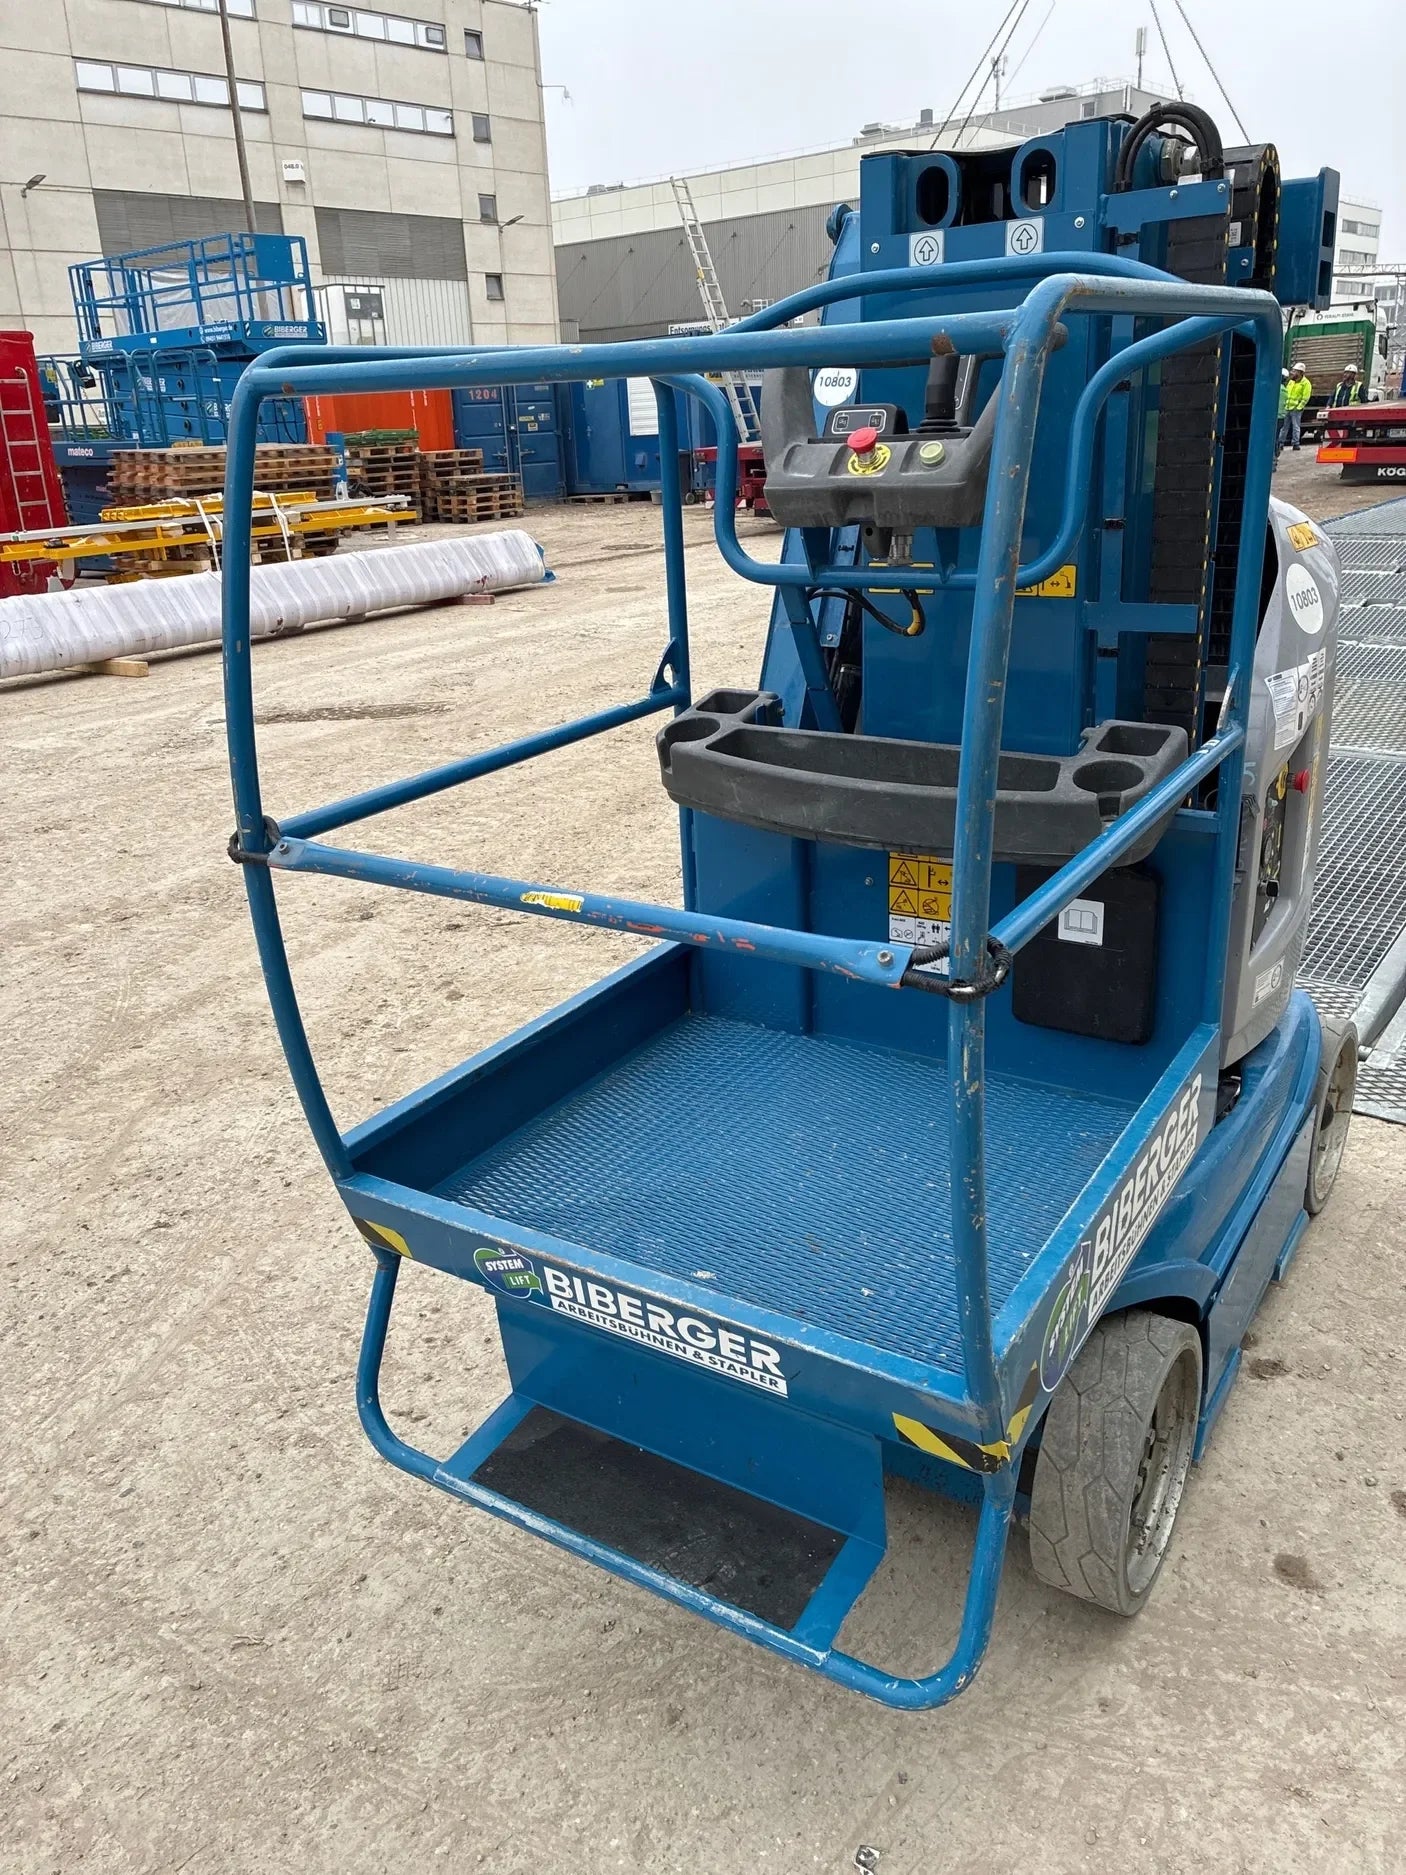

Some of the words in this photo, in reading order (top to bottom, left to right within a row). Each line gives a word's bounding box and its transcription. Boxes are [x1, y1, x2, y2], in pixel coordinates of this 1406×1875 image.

[274, 325, 307, 333] BIBERGER
[819, 376, 852, 387] 10803
[469, 389, 497, 400] 1204
[67, 446, 94, 457] mateco
[1290, 587, 1319, 611] 10803
[1091, 1073, 1202, 1287] BIBERGER
[485, 1258, 525, 1272] SYSTEM
[509, 1274, 531, 1286] LIFT
[1049, 1256, 1084, 1357] SYSTEM
[543, 1266, 785, 1377] BIBERGER
[557, 1300, 687, 1355] ARBEITSBÜHNEN
[692, 1349, 705, 1361] &
[708, 1356, 781, 1389] STAPLER
